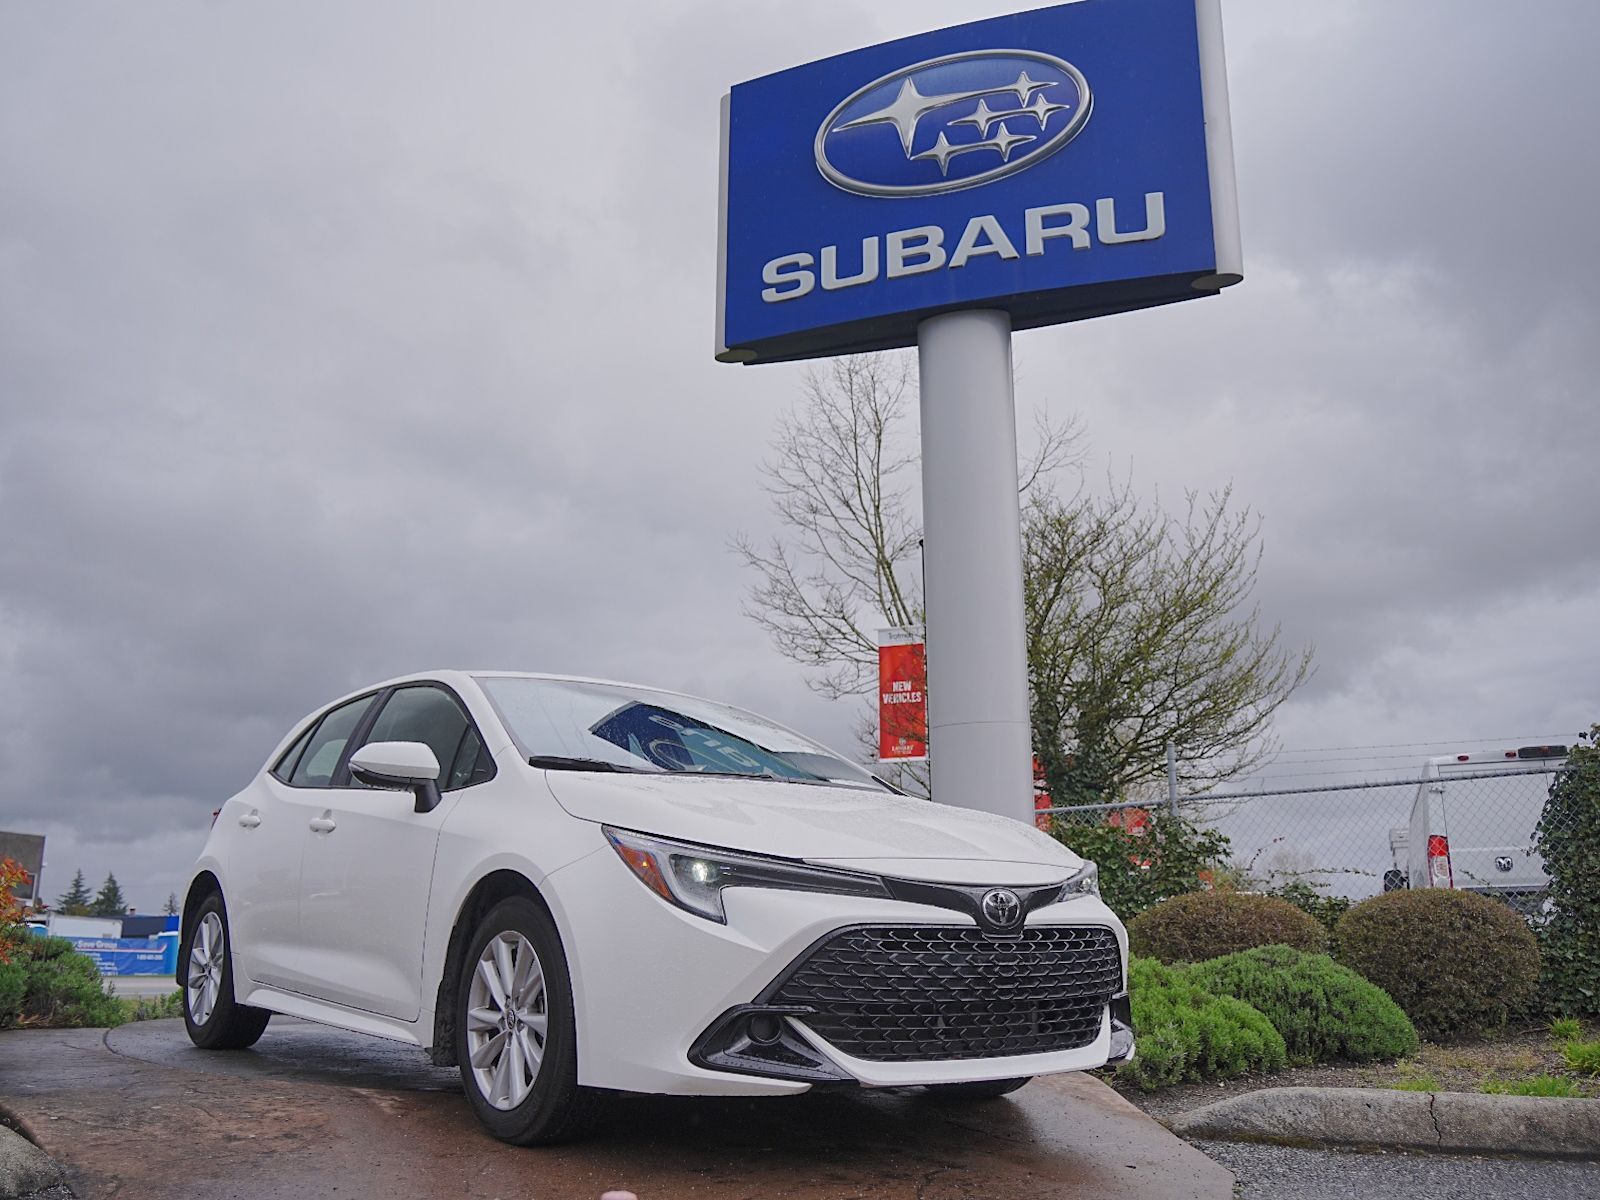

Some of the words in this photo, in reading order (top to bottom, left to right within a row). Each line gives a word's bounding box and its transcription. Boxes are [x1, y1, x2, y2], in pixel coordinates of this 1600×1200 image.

[761, 191, 1166, 303] SUBARU
[892, 681, 912, 692] NEW
[882, 692, 922, 705] VEHICLES
